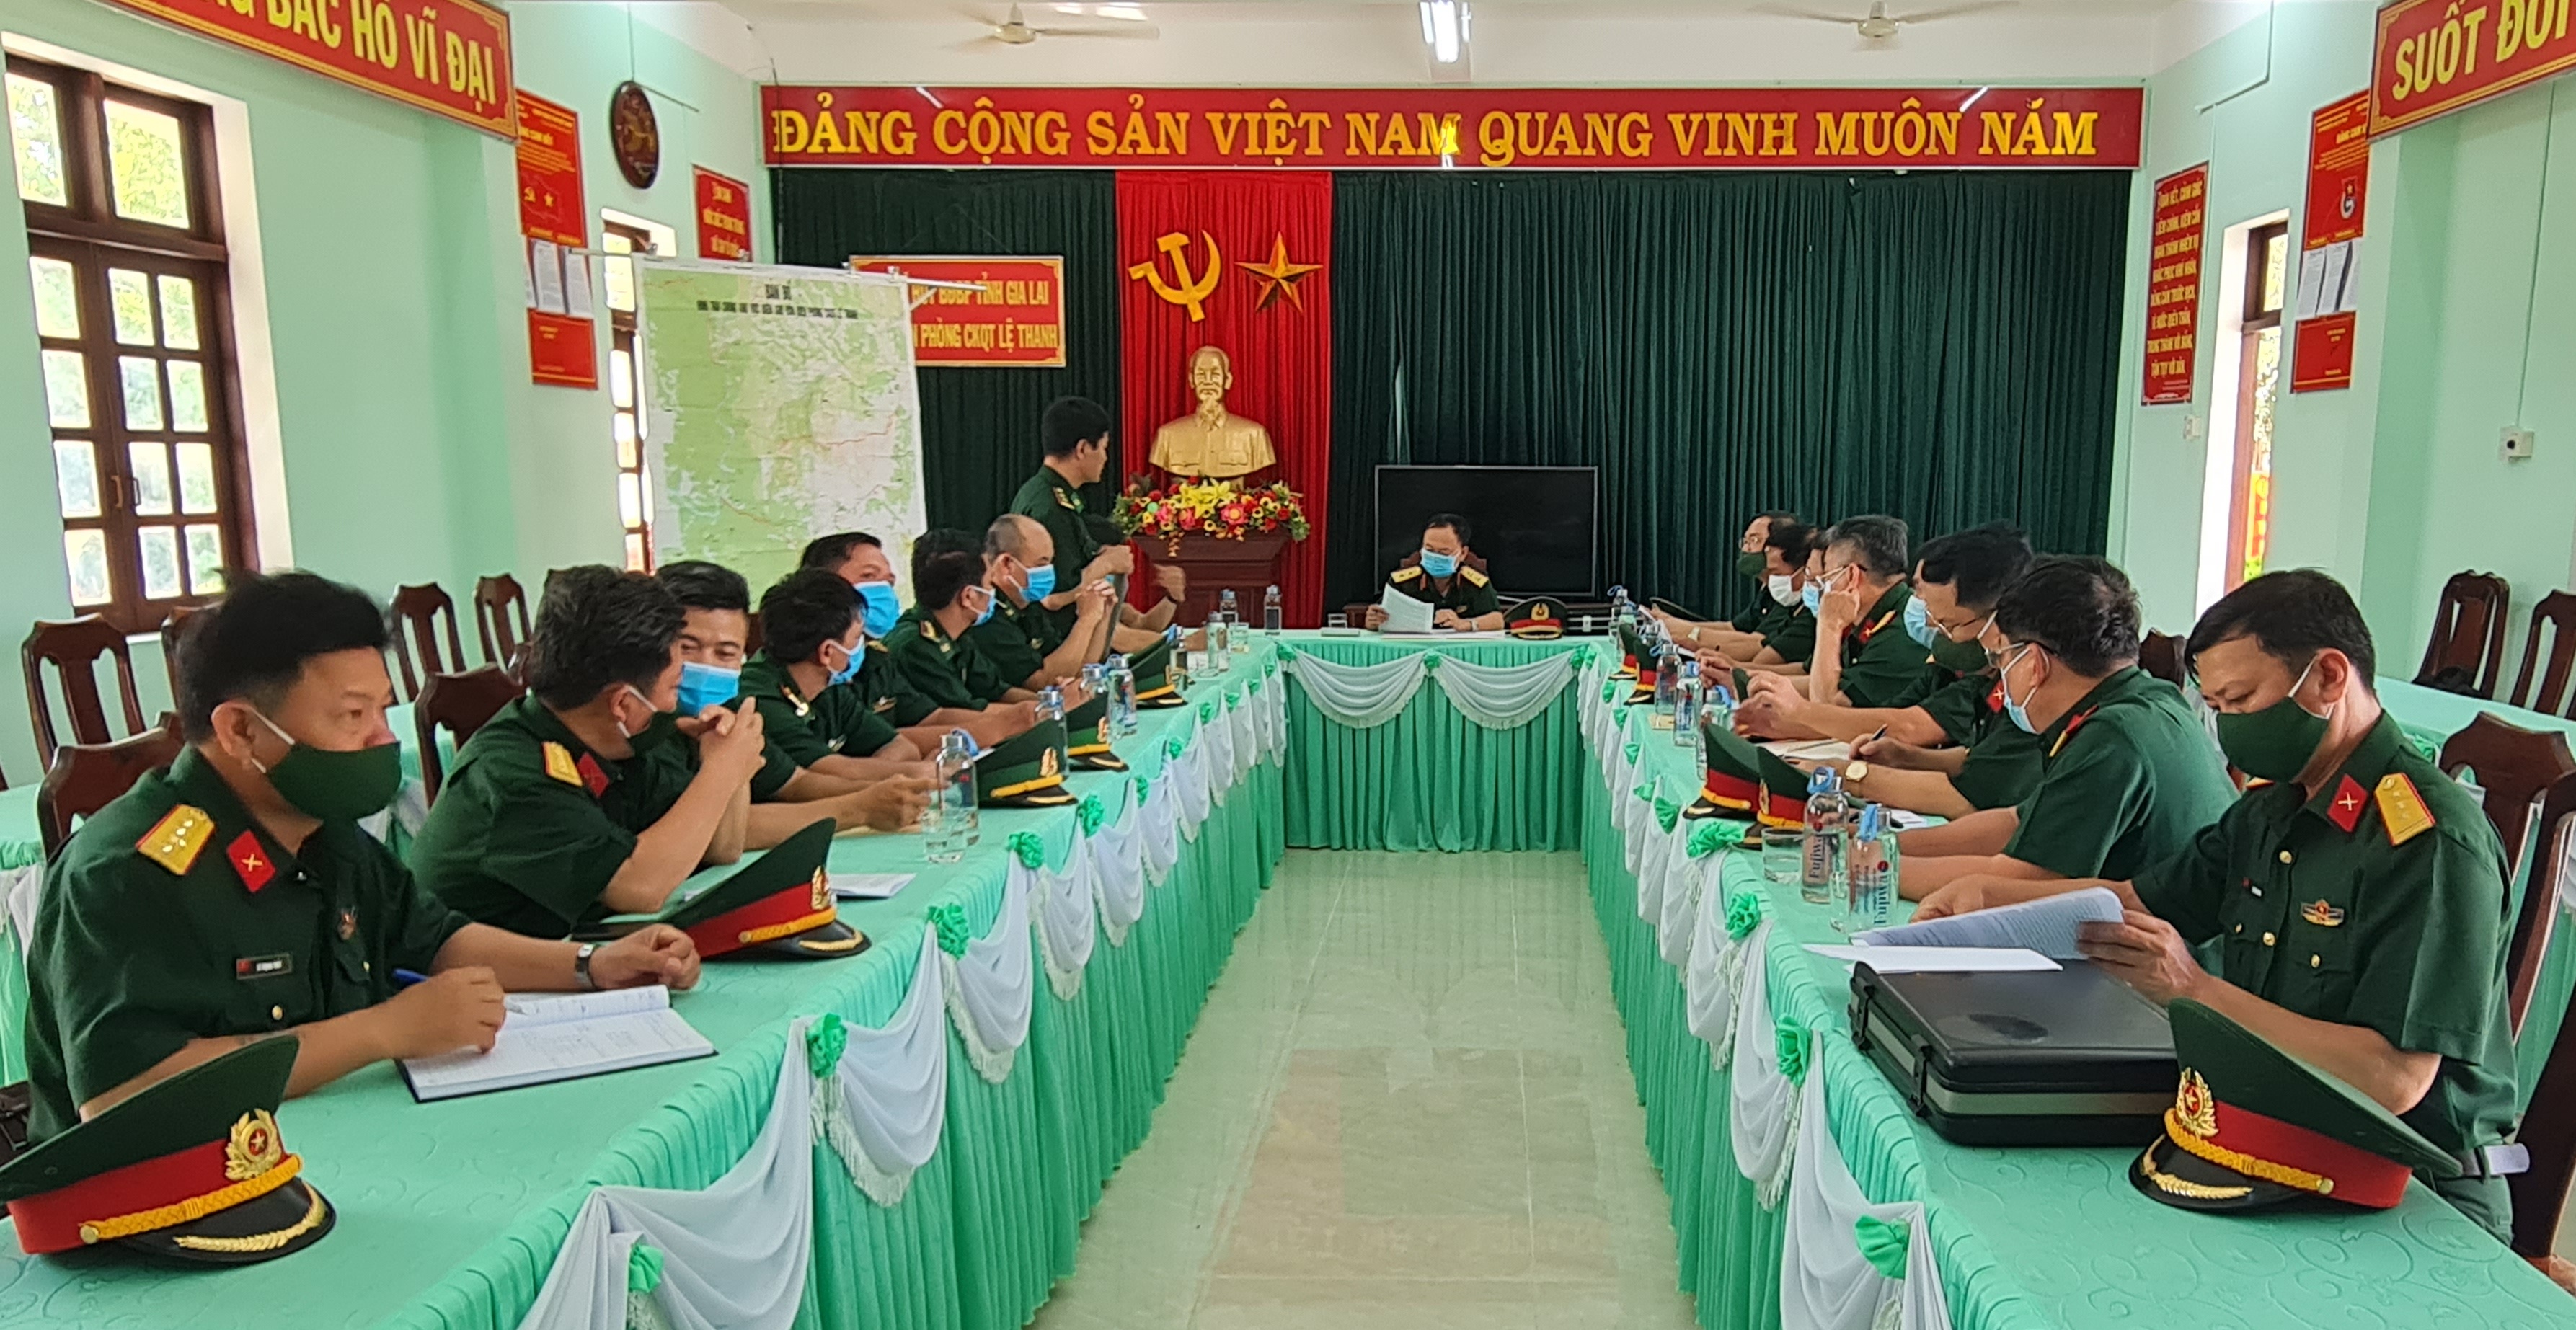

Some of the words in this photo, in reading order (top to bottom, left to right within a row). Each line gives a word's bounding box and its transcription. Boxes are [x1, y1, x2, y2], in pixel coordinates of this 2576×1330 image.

[404, 6, 440, 85] VĨ
[445, 30, 497, 113] ĐẠI
[771, 92, 918, 155] ĐẢNG
[932, 96, 1072, 165] CỘNG
[1086, 93, 1190, 156] SẢN
[1205, 97, 1332, 167] VIỆT
[1345, 112, 1462, 156] NAM
[1479, 110, 1653, 167] QUANG
[1667, 112, 1798, 156] VINH
[1815, 97, 1962, 156] MUÔN
[1006, 280, 1027, 305] GIA
[1029, 280, 1050, 305] LAI
[921, 316, 962, 348] PHÒNG
[963, 323, 996, 353] CKQT
[997, 316, 1015, 353] LỆ
[1017, 324, 1058, 348] THANH
